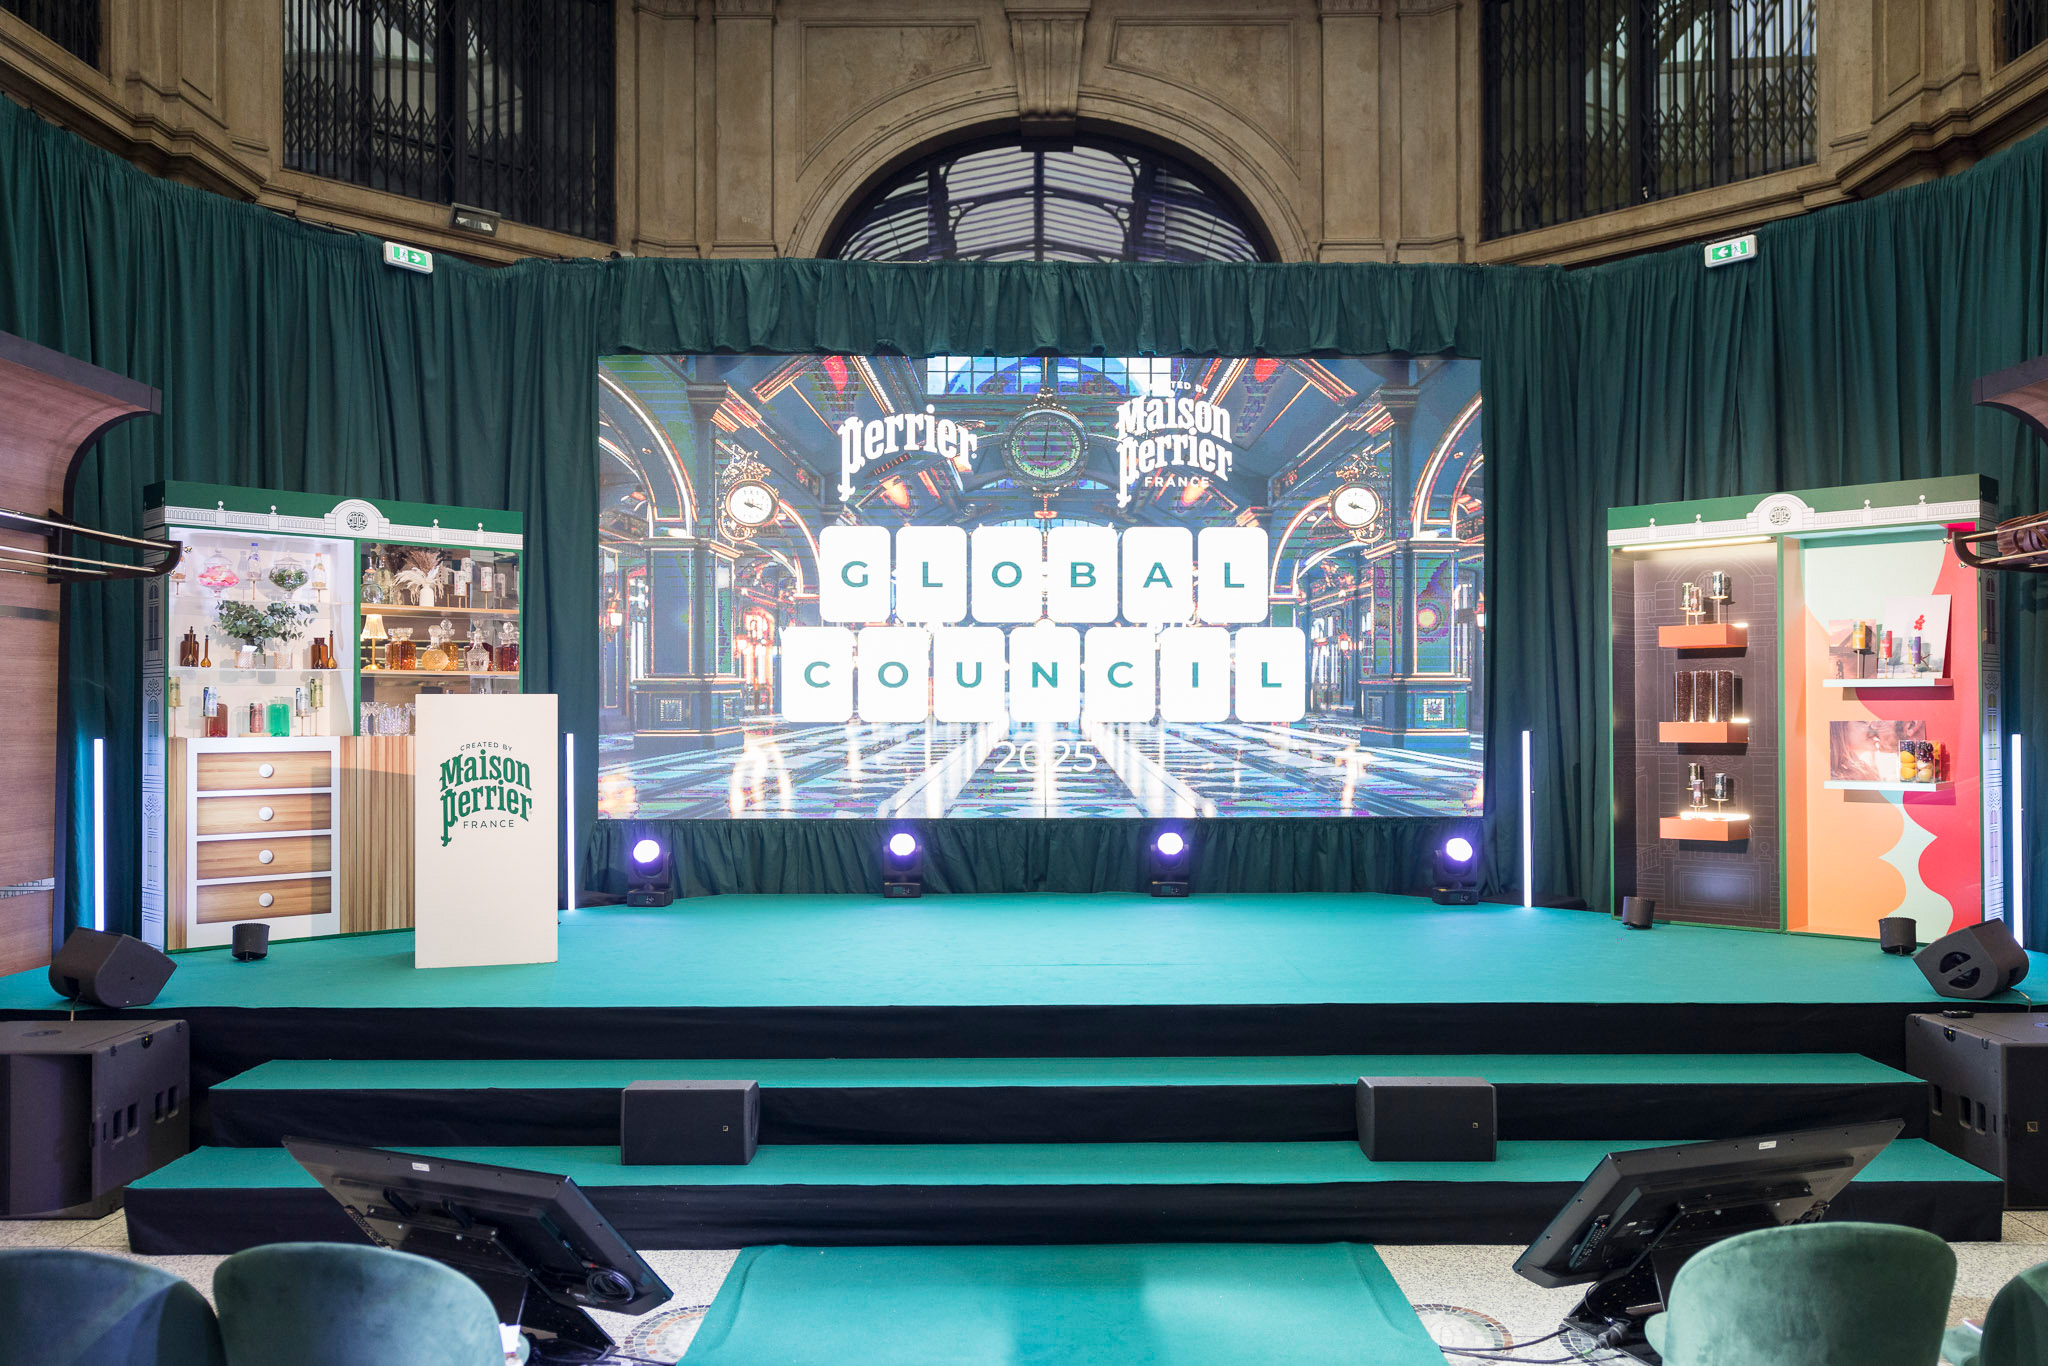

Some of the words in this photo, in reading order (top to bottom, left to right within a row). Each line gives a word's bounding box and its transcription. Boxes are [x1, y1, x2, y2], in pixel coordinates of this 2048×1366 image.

[1115, 390, 1233, 444] Maison
[1144, 476, 1210, 488] FRANCE
[841, 560, 1246, 589] GLOBAL
[803, 661, 1282, 689] COUNCIL
[460, 741, 499, 752] CREATED
[502, 743, 513, 752] BY
[993, 740, 1097, 773] 2025
[439, 748, 533, 793] Maison
[463, 819, 515, 830] FRANCE
